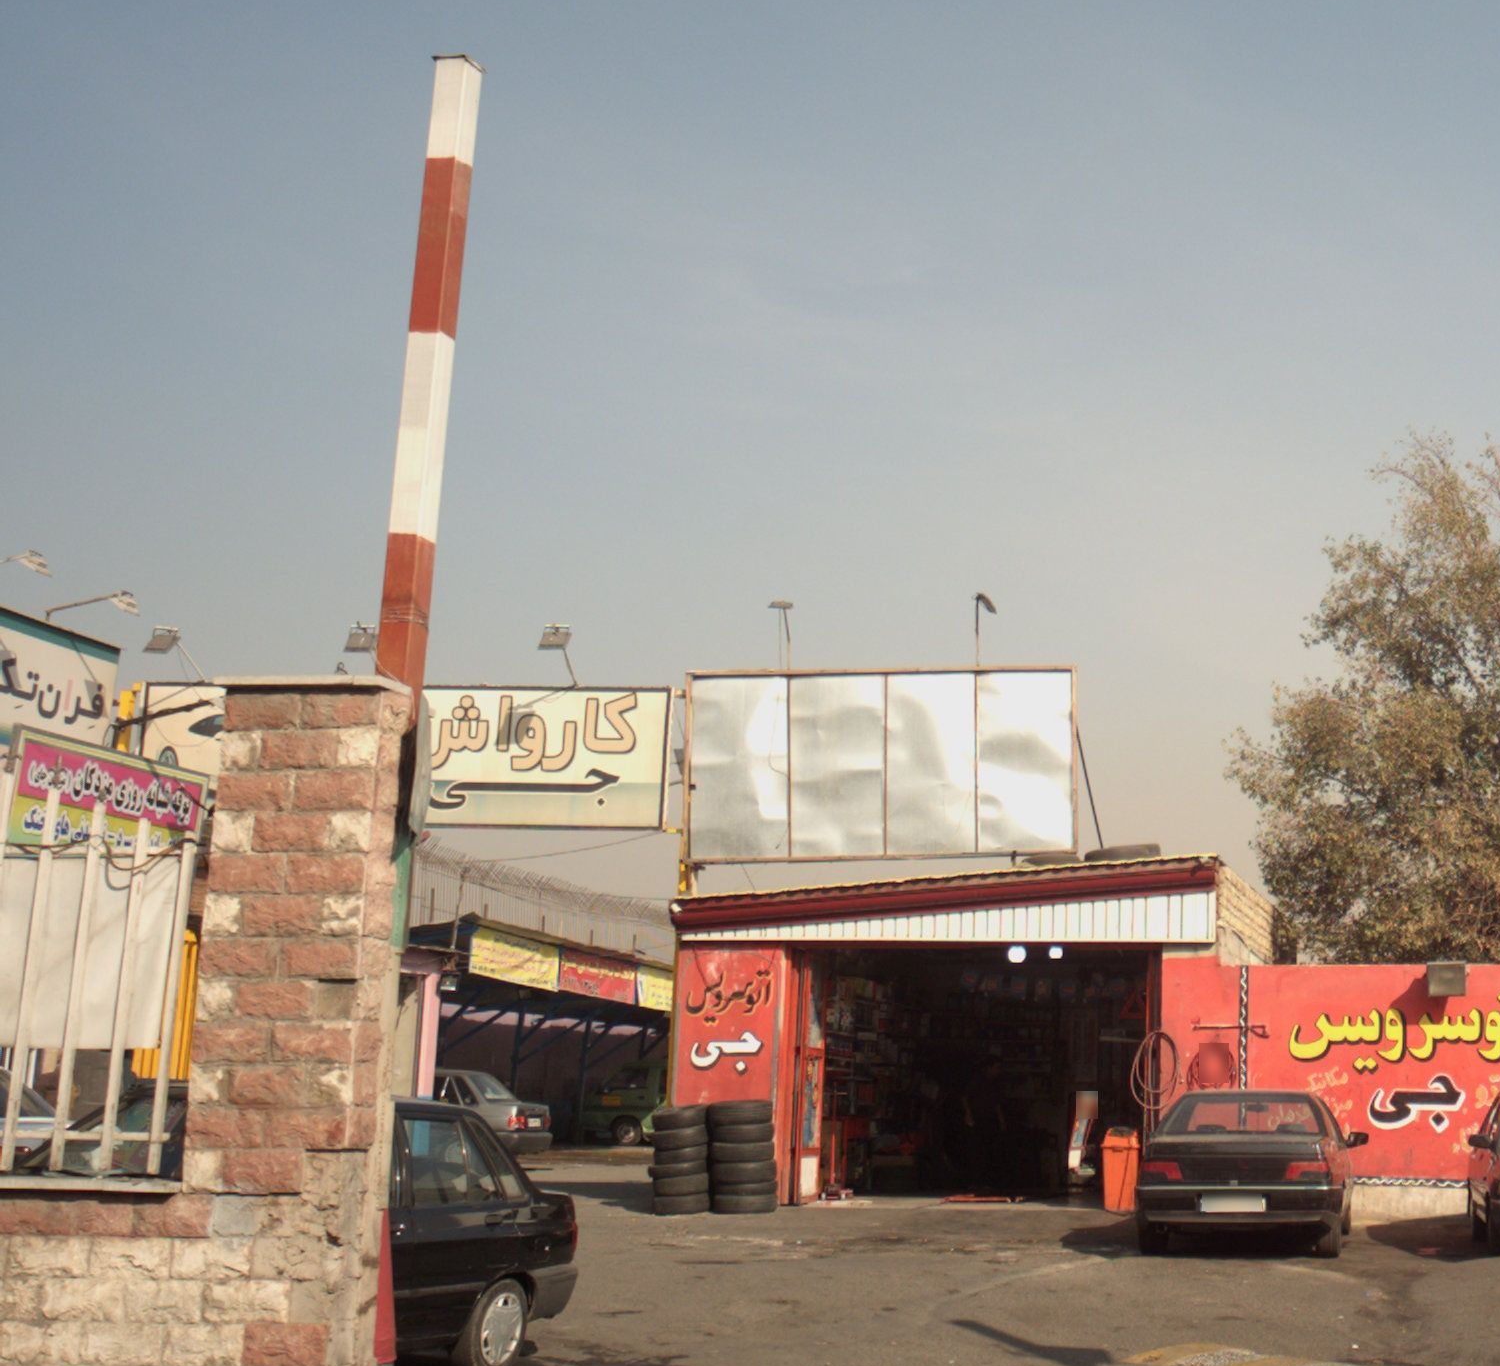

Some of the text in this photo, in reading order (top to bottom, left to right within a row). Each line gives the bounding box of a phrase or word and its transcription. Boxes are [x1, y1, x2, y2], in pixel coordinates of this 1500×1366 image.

[431, 692, 638, 772] کارواش
[429, 768, 620, 810] جی
[685, 969, 773, 1026] اتوسرویس
[690, 1031, 763, 1074] جی
[1367, 1072, 1465, 1134] جی
